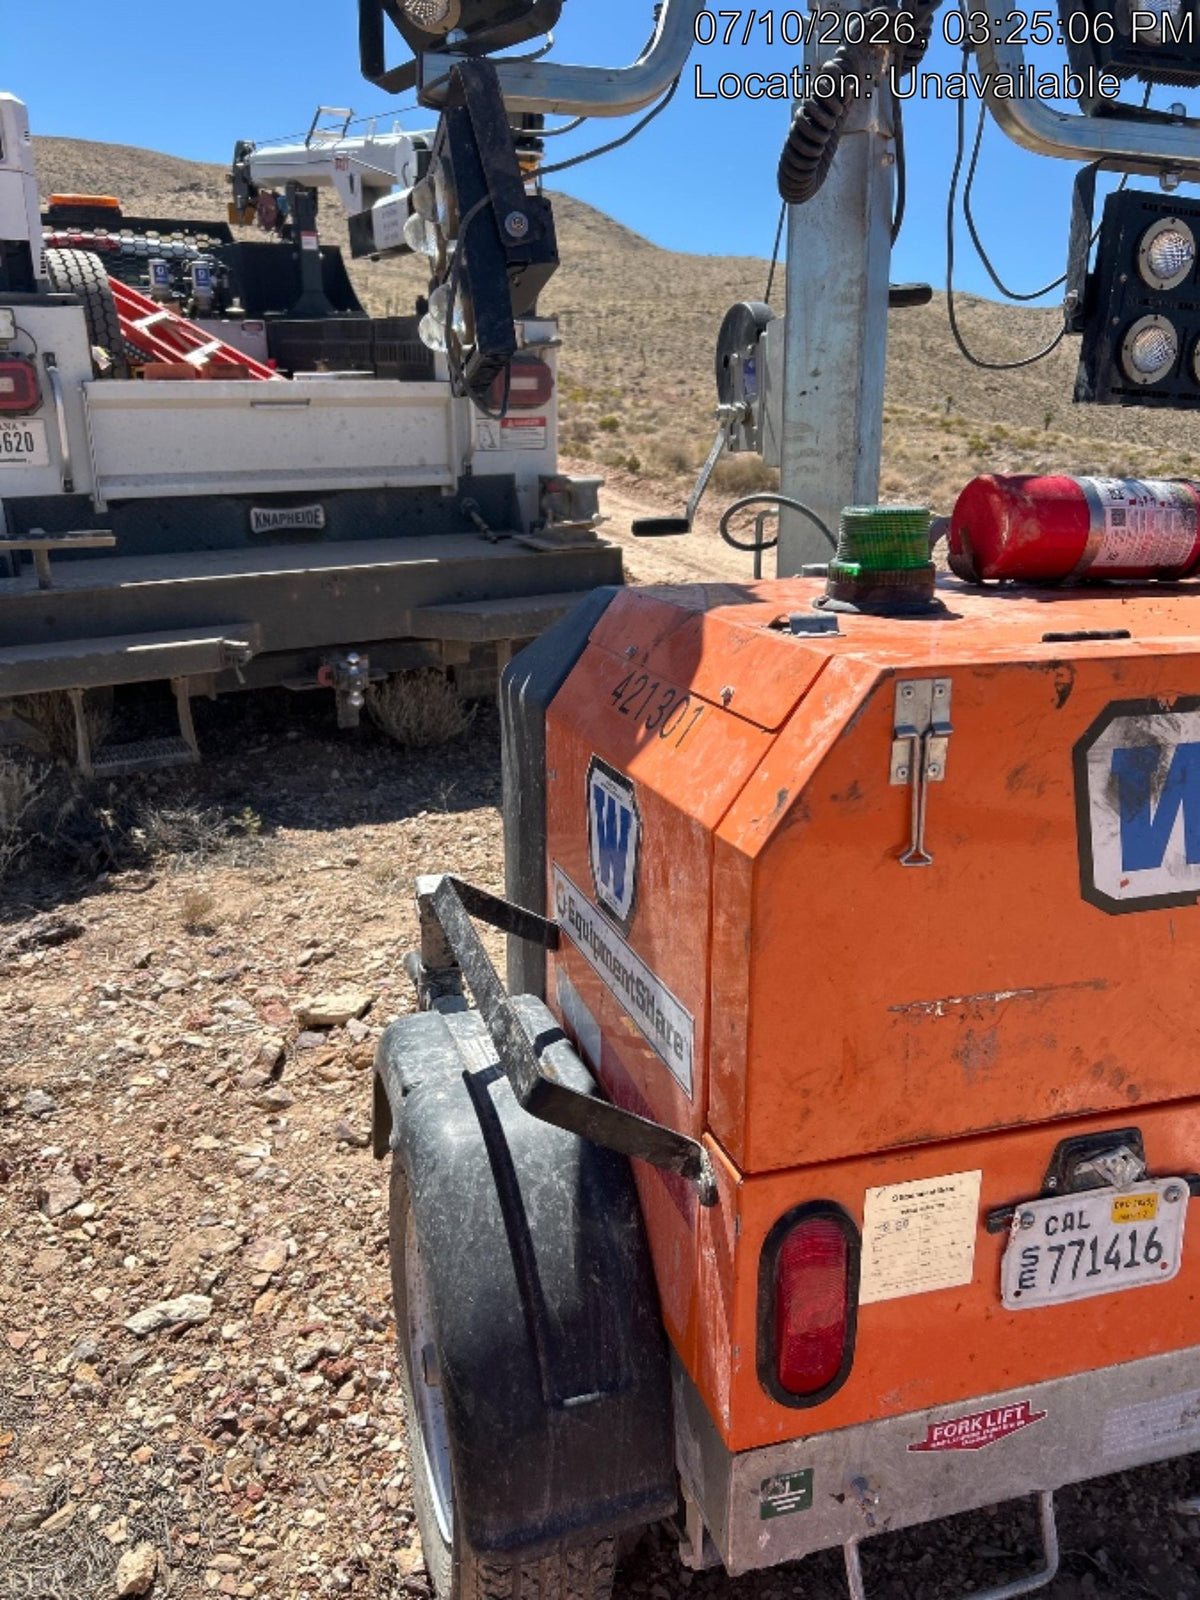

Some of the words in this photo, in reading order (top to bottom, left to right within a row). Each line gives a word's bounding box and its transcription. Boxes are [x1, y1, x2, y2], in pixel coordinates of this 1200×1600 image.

[0, 431, 34, 453] 620
[254, 508, 322, 529] KNAPHEIDE
[611, 670, 705, 749] 421301
[568, 895, 685, 1062] EquipmentShare
[1045, 1210, 1091, 1236] CAL
[1047, 1226, 1164, 1285] 771416
[932, 1416, 983, 1441] FORK
[986, 1405, 1026, 1427] LIFT
